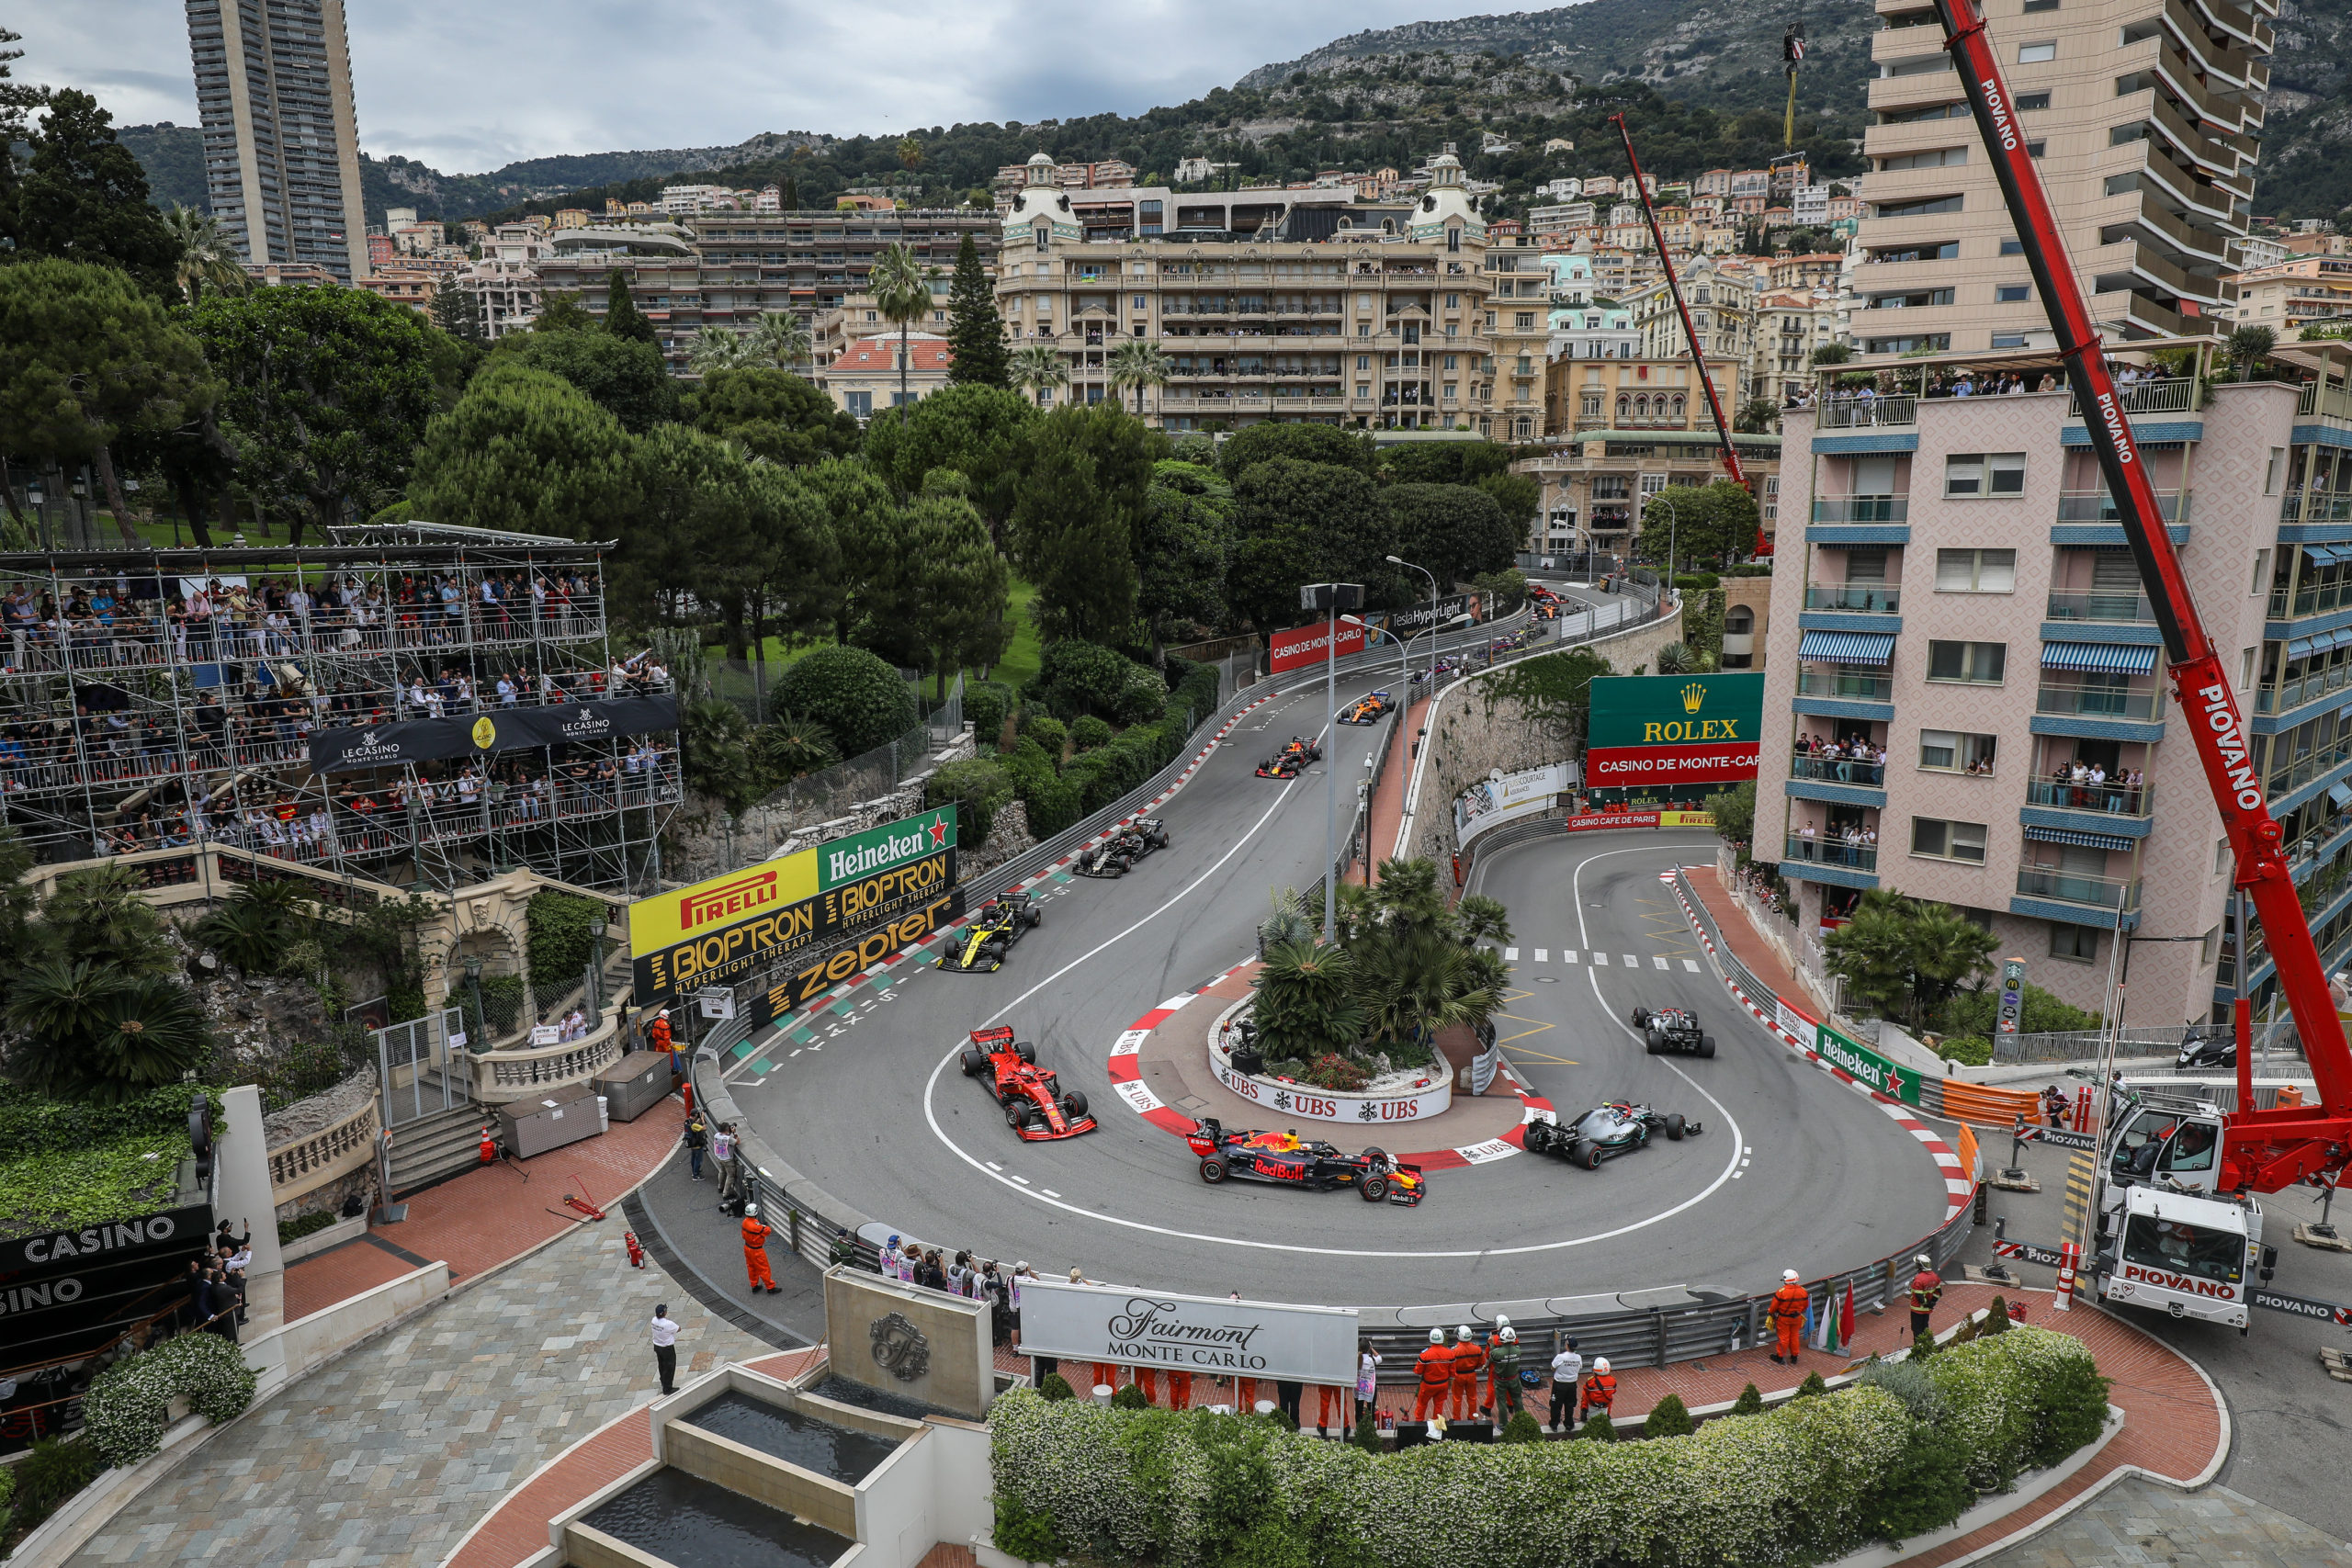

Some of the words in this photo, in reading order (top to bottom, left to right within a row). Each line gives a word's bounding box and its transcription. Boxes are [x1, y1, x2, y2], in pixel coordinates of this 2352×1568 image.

[1981, 77, 2018, 152] PIOVANO
[2097, 390, 2133, 466] PIOVANO
[1733, 454, 1745, 481] PIOVANO
[1274, 642, 1300, 660] CASINO
[1301, 640, 1311, 651] DE
[1311, 628, 1362, 649] MONT-CARLO
[562, 722, 577, 732] LE
[578, 718, 611, 730] CASINO
[1643, 719, 1739, 742] ROLEX
[342, 746, 362, 759] LE
[364, 743, 400, 757] CASINO
[2198, 683, 2262, 811] PIOVANO
[1599, 759, 1654, 773] CASINO
[1657, 758, 1677, 771] DE
[1631, 796, 1658, 806] ROLEX
[1571, 818, 1599, 828] CASINO
[1600, 816, 1618, 825] CAFE
[1619, 816, 1632, 824] DE
[1634, 815, 1657, 824] PARIS
[829, 830, 924, 882] Heineken
[842, 854, 946, 917] BIOPTRON
[681, 871, 778, 931] PIRELLI
[842, 897, 903, 929] HYPERLIGHT
[908, 881, 945, 904] THERAPY
[673, 902, 814, 982] BIOPTRON
[797, 896, 952, 1000] zepter
[675, 957, 755, 996] HYPERLIGHT
[762, 932, 814, 961] THERAPY
[1118, 1038, 1137, 1055] UBS
[1823, 1034, 1881, 1086] Heineken
[1129, 1090, 1157, 1110] UBS
[1230, 1075, 1259, 1100] UBS
[1295, 1095, 1337, 1118] UBS
[1381, 1099, 1419, 1121] UBS
[1190, 1138, 1210, 1146] ESSO
[1236, 1146, 1257, 1156] HONDA
[1477, 1141, 1512, 1156] UBS
[1391, 1194, 1408, 1202] Mobil
[25, 1216, 175, 1263] CASINO
[2124, 1265, 2236, 1301] PIOVANO
[2256, 1293, 2330, 1318] PIOVANO
[1108, 1297, 1265, 1351] Fairmont
[1107, 1340, 1183, 1362] MONTE
[1192, 1349, 1267, 1371] CARLO
